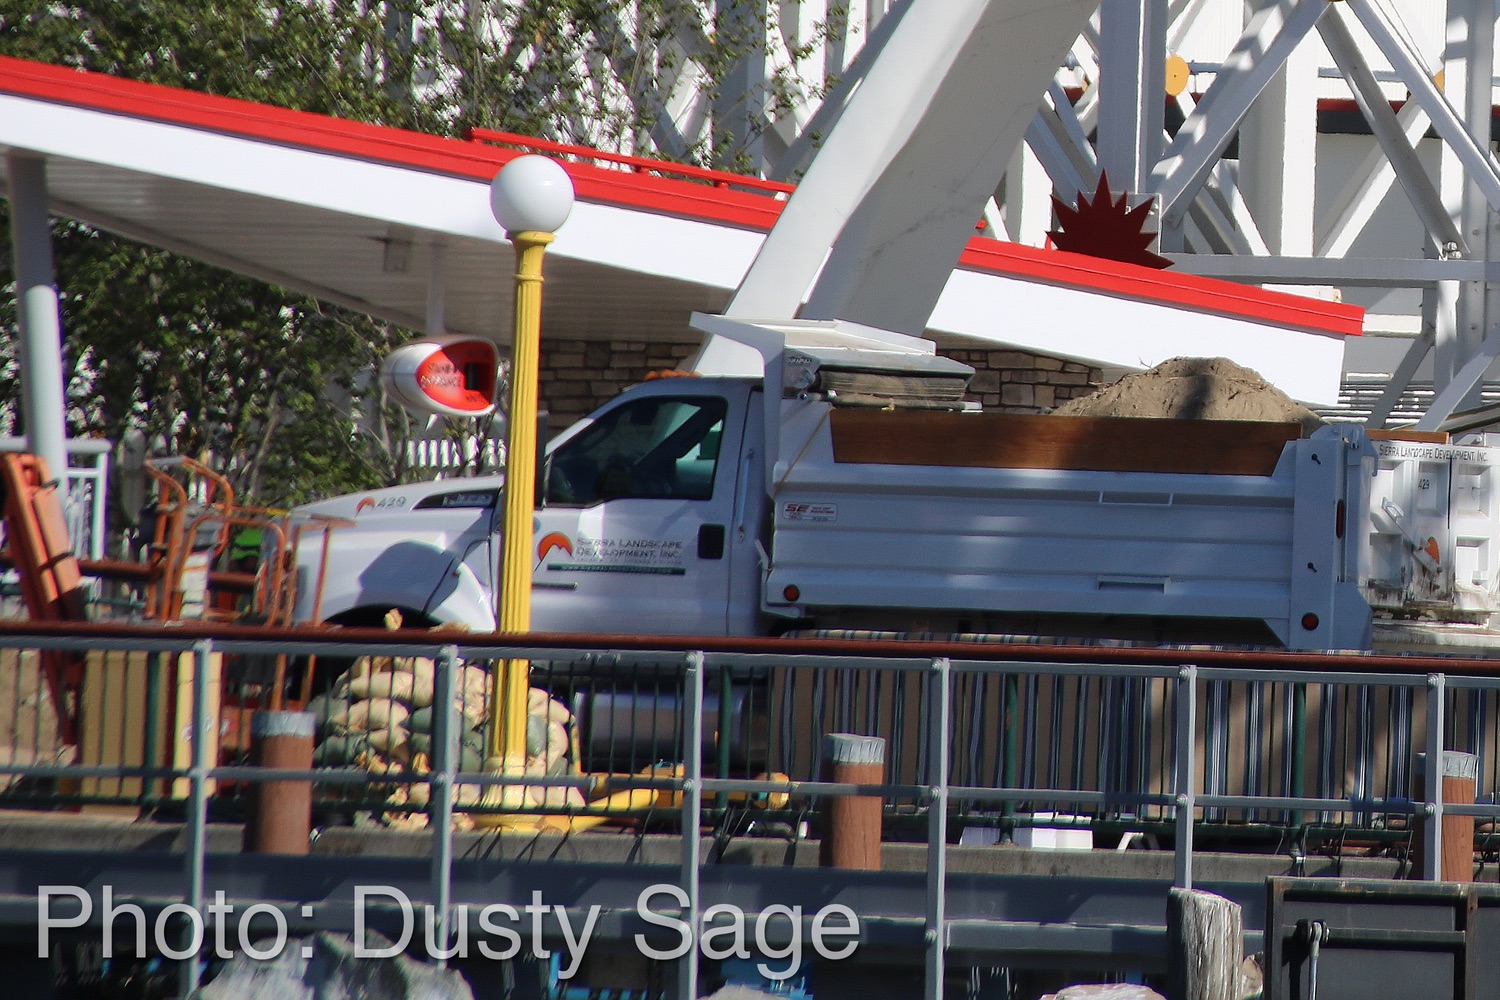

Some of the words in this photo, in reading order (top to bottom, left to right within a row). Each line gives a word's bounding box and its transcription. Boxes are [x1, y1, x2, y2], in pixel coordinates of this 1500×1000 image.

[1379, 444, 1399, 457] SIERRA
[1400, 446, 1433, 459] LANDSCAPE
[618, 539, 683, 549] LANDSCAPE
